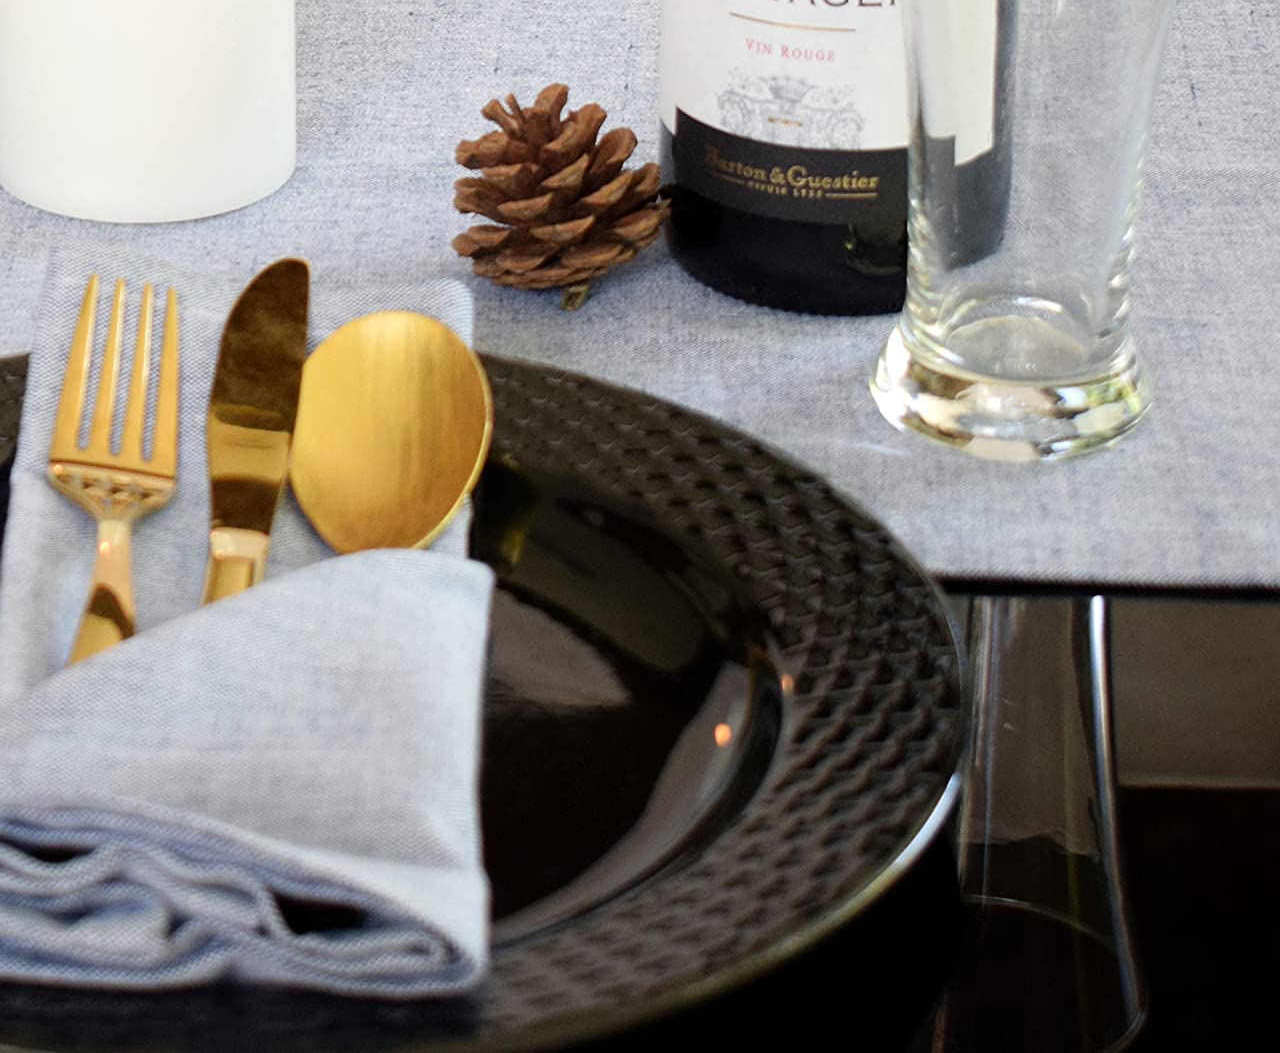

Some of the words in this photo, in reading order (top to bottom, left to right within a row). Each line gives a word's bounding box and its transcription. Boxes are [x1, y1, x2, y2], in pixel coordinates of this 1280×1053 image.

[745, 38, 772, 55] VIN
[780, 45, 836, 62] ROUGE
[786, 165, 880, 190] Guestier
